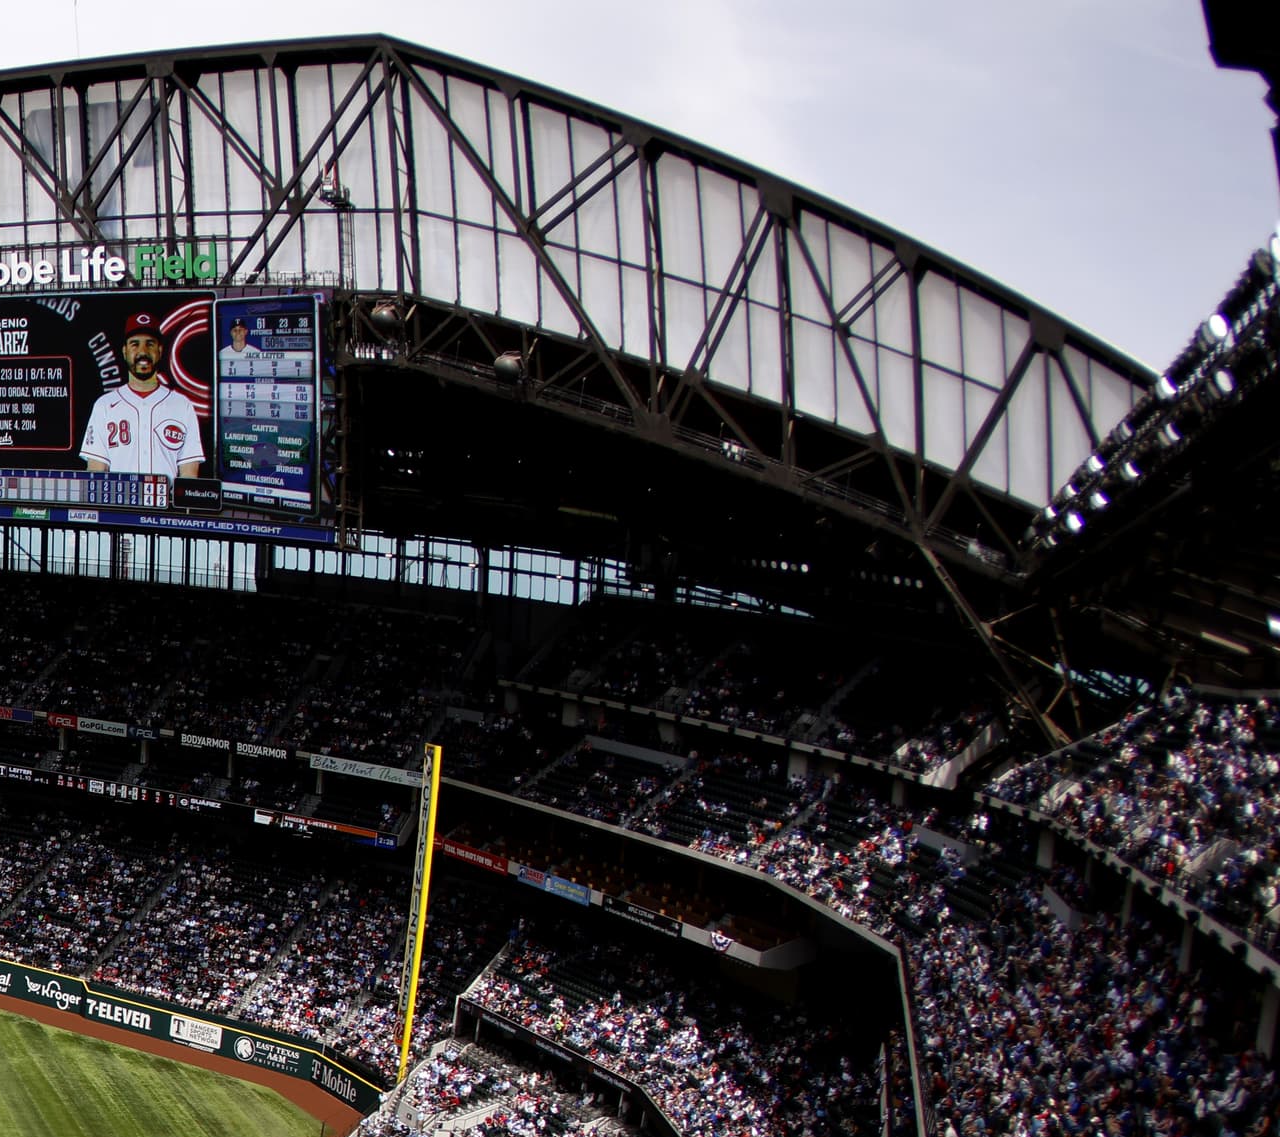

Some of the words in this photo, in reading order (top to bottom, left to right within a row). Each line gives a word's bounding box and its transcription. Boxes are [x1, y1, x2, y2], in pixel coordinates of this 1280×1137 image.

[62, 246, 126, 283] Life
[134, 242, 217, 280] Field
[107, 420, 131, 448] 28
[230, 446, 254, 454] SEAGER
[278, 450, 300, 458] SMITH
[70, 511, 85, 519] LAST
[88, 511, 96, 519] AB
[140, 516, 158, 525] SAL
[160, 518, 205, 528] STEWART
[207, 520, 234, 530] FLIED
[235, 523, 249, 532] TO
[251, 524, 281, 535] RIGHT
[55, 717, 74, 728] PGL
[79, 719, 126, 734] GoPGL.com
[181, 733, 230, 750] BODYARMOR
[236, 742, 287, 759] BODYARMOR
[312, 755, 341, 769] Blue
[342, 761, 375, 776] Mint
[41, 980, 82, 1010] Kroger
[88, 999, 151, 1030] 7-ELEVEN
[172, 1018, 185, 1034] T
[190, 1021, 218, 1034] RANGERS
[190, 1027, 213, 1040] SPORTS
[190, 1032, 219, 1046] NETWORK
[256, 1041, 274, 1052] EAST
[275, 1044, 300, 1060] TEXAS
[266, 1052, 287, 1064] A&M
[253, 1056, 299, 1073] UNIVERSITY
[322, 1064, 356, 1102] Mobile
